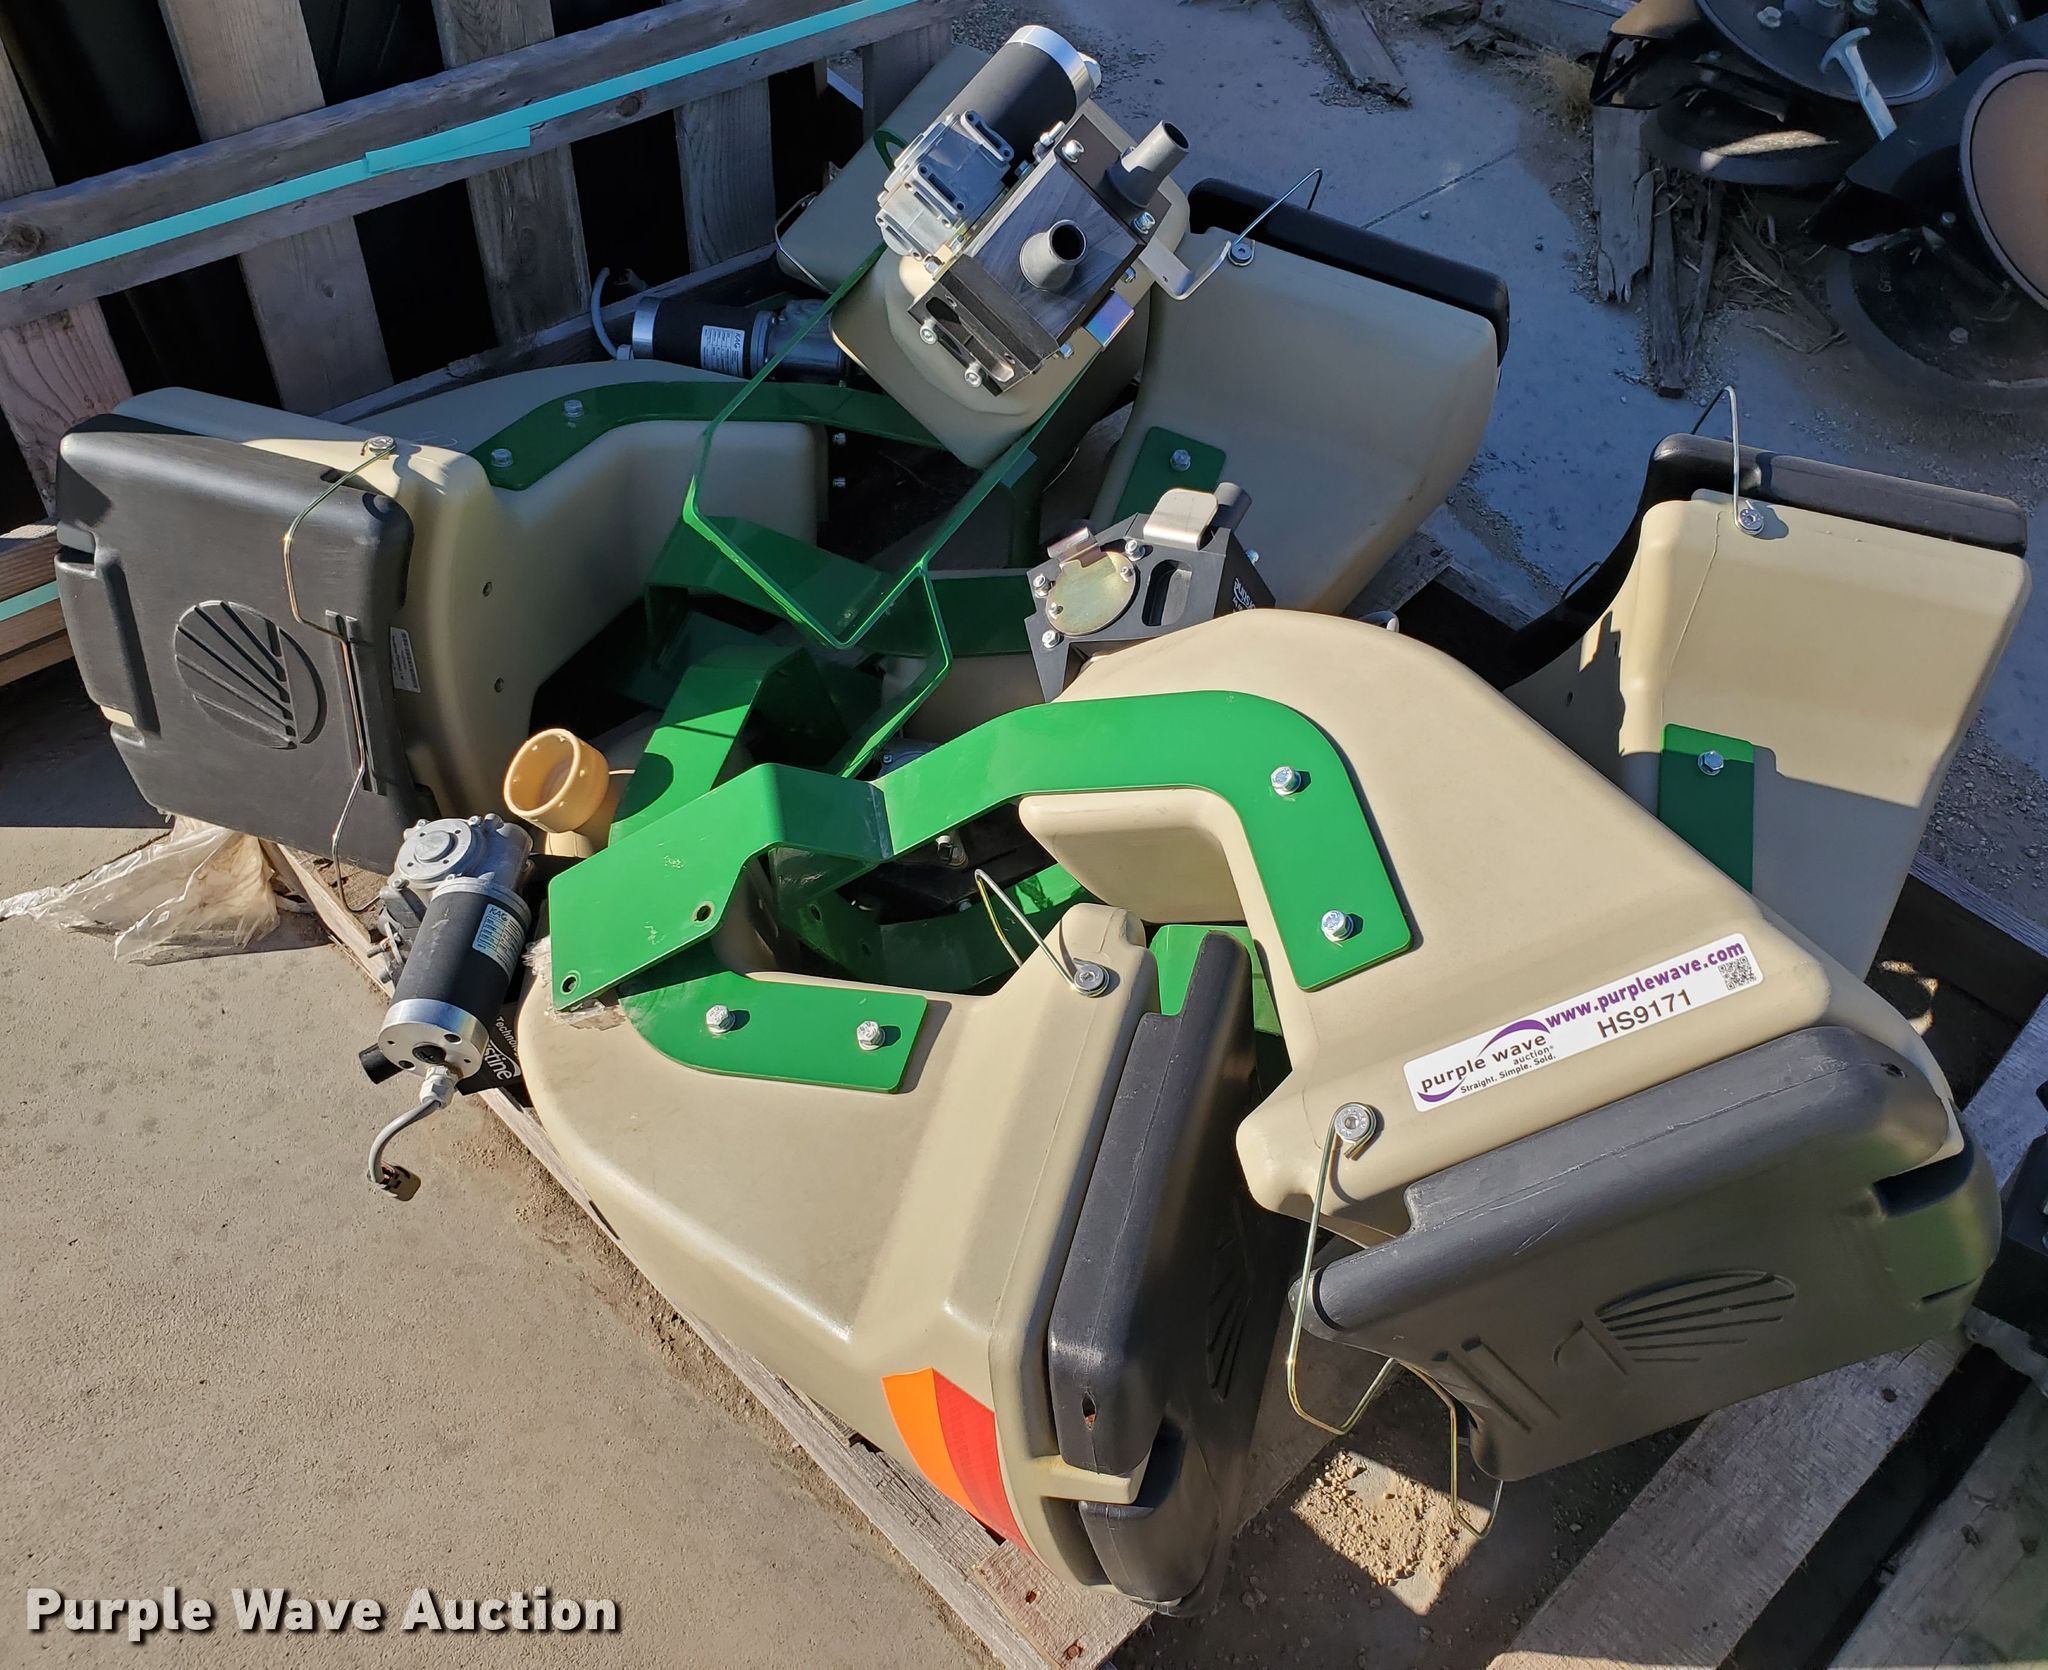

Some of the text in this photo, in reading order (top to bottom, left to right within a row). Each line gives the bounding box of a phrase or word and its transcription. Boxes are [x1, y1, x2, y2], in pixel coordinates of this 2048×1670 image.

[1545, 942, 1744, 1028] www.purplewave.com
[496, 1016, 519, 1059] Techno
[1597, 989, 1691, 1038] HS9171
[1421, 1035, 1547, 1092] purple wave
[1460, 1053, 1557, 1093] Straight. Simple. Sold.
